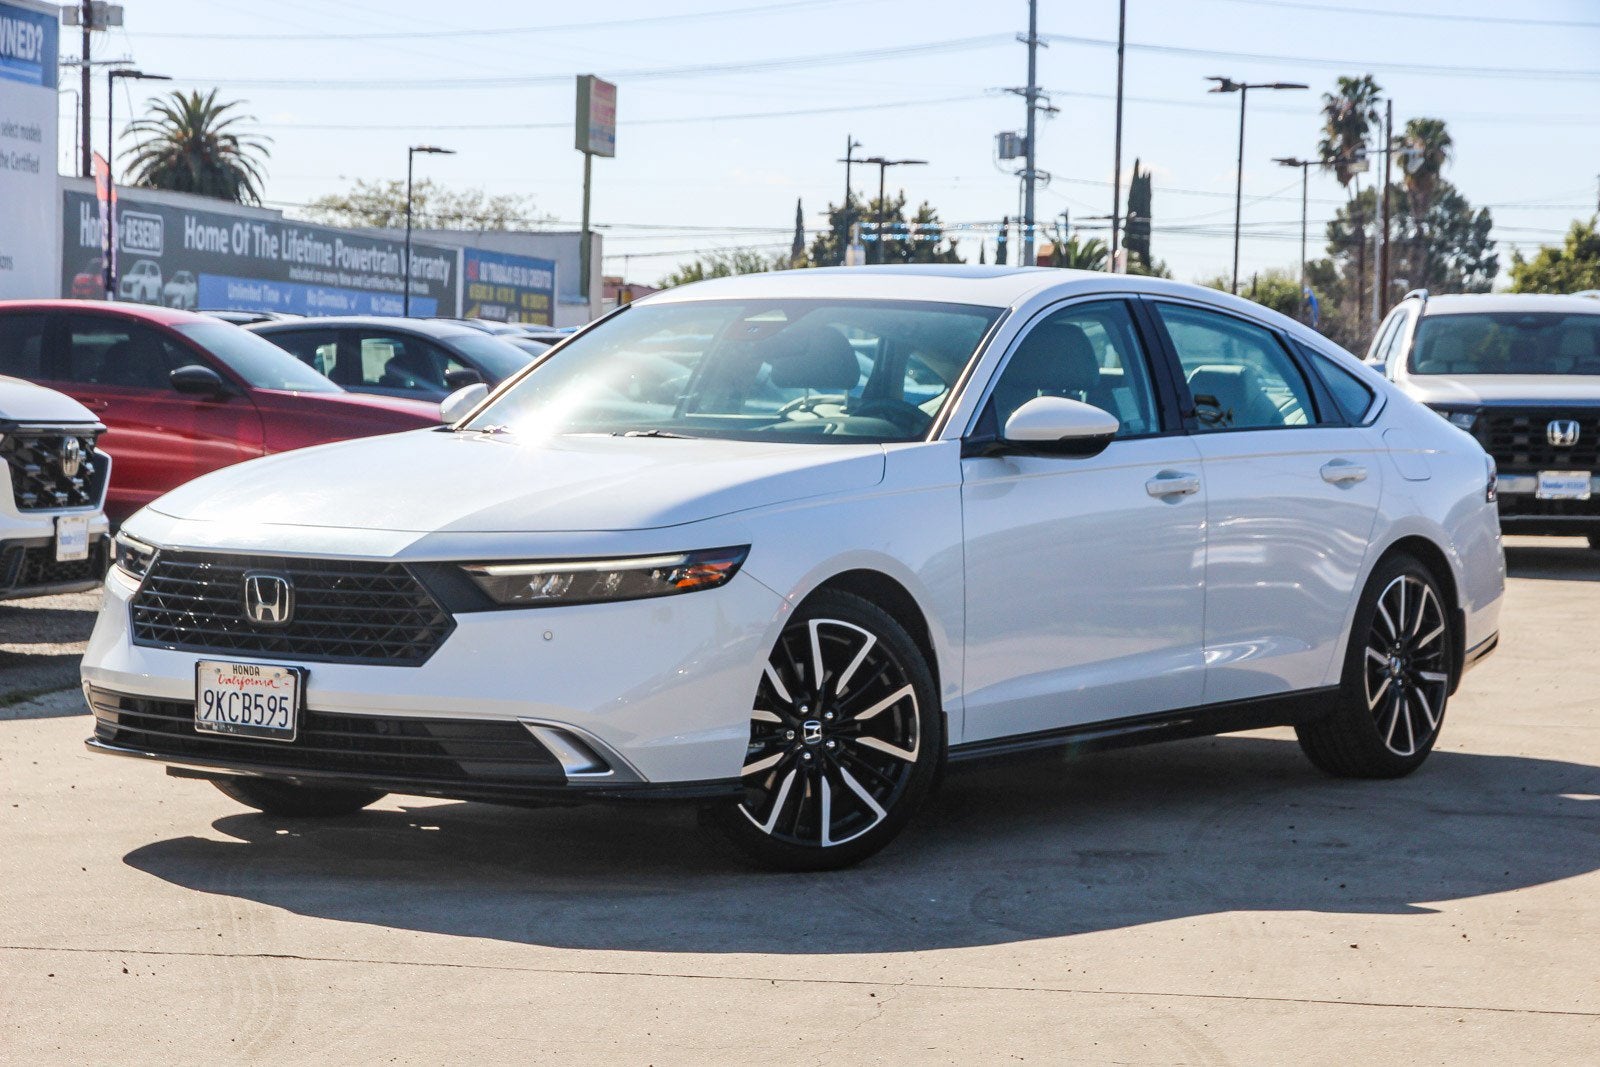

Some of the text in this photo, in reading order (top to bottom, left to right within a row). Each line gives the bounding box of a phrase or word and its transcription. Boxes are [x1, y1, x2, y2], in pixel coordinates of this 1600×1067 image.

[184, 215, 229, 254] Home
[231, 222, 250, 255] Of
[253, 223, 279, 259] The
[281, 229, 333, 267] Lifetime
[335, 238, 399, 274] Powertrain
[218, 674, 280, 690] California
[232, 665, 260, 676] HONDA
[204, 690, 289, 728] 9KCB595
